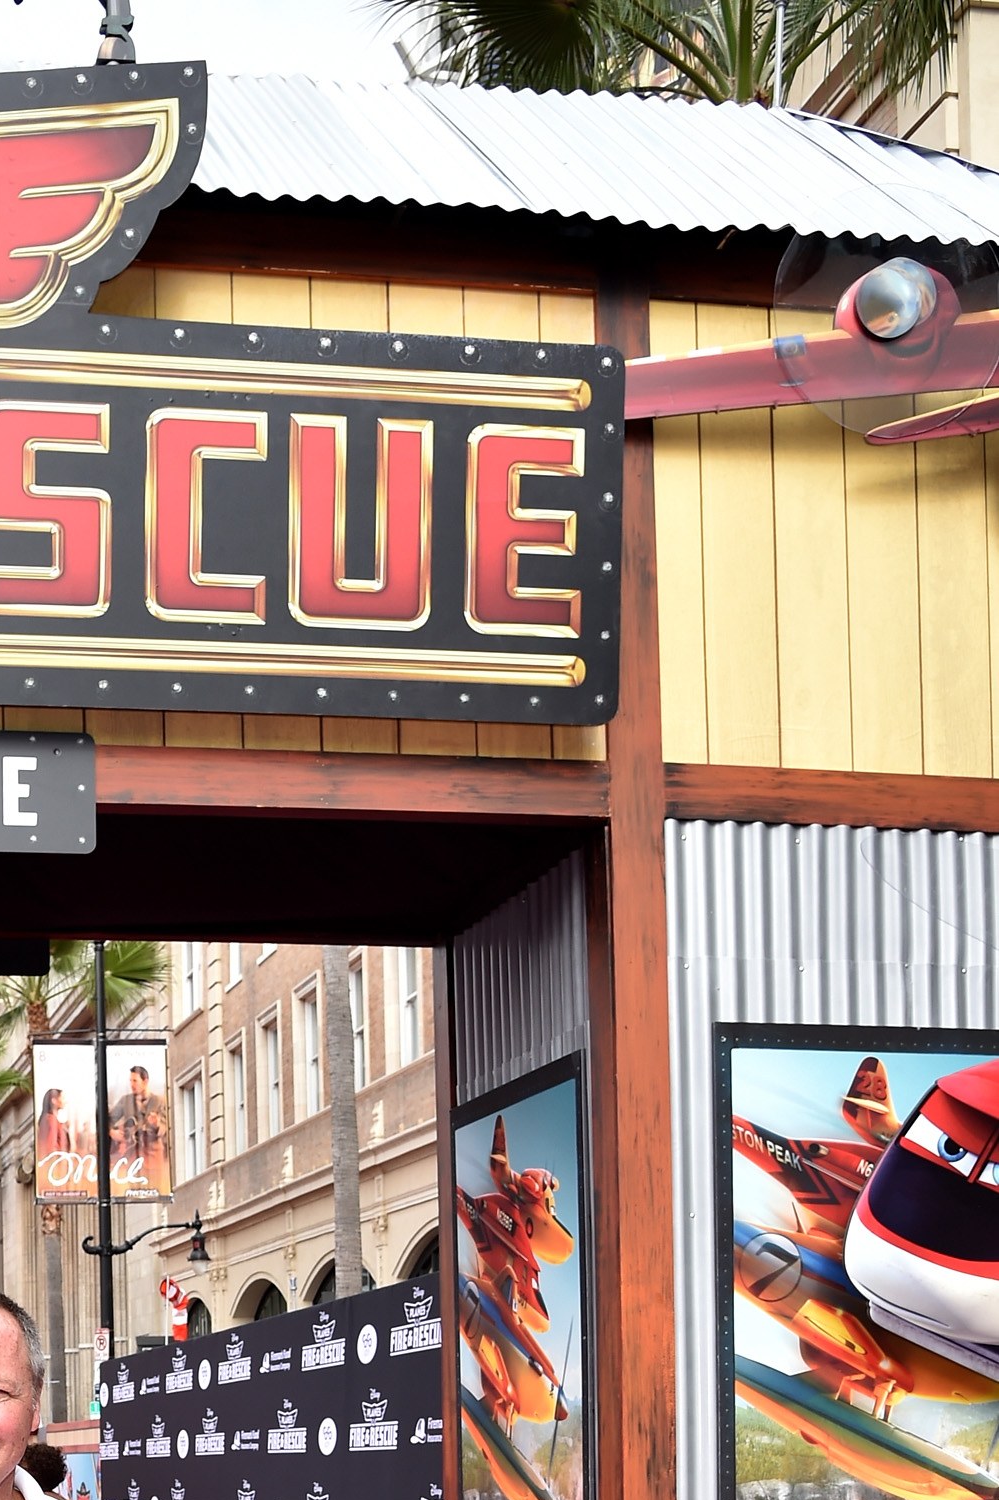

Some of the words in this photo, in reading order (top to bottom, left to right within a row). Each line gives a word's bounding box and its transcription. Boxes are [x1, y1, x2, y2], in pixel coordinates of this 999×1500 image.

[855, 1069, 888, 1101] 28
[766, 1140, 802, 1172] PEAK
[747, 1241, 800, 1299] 7
